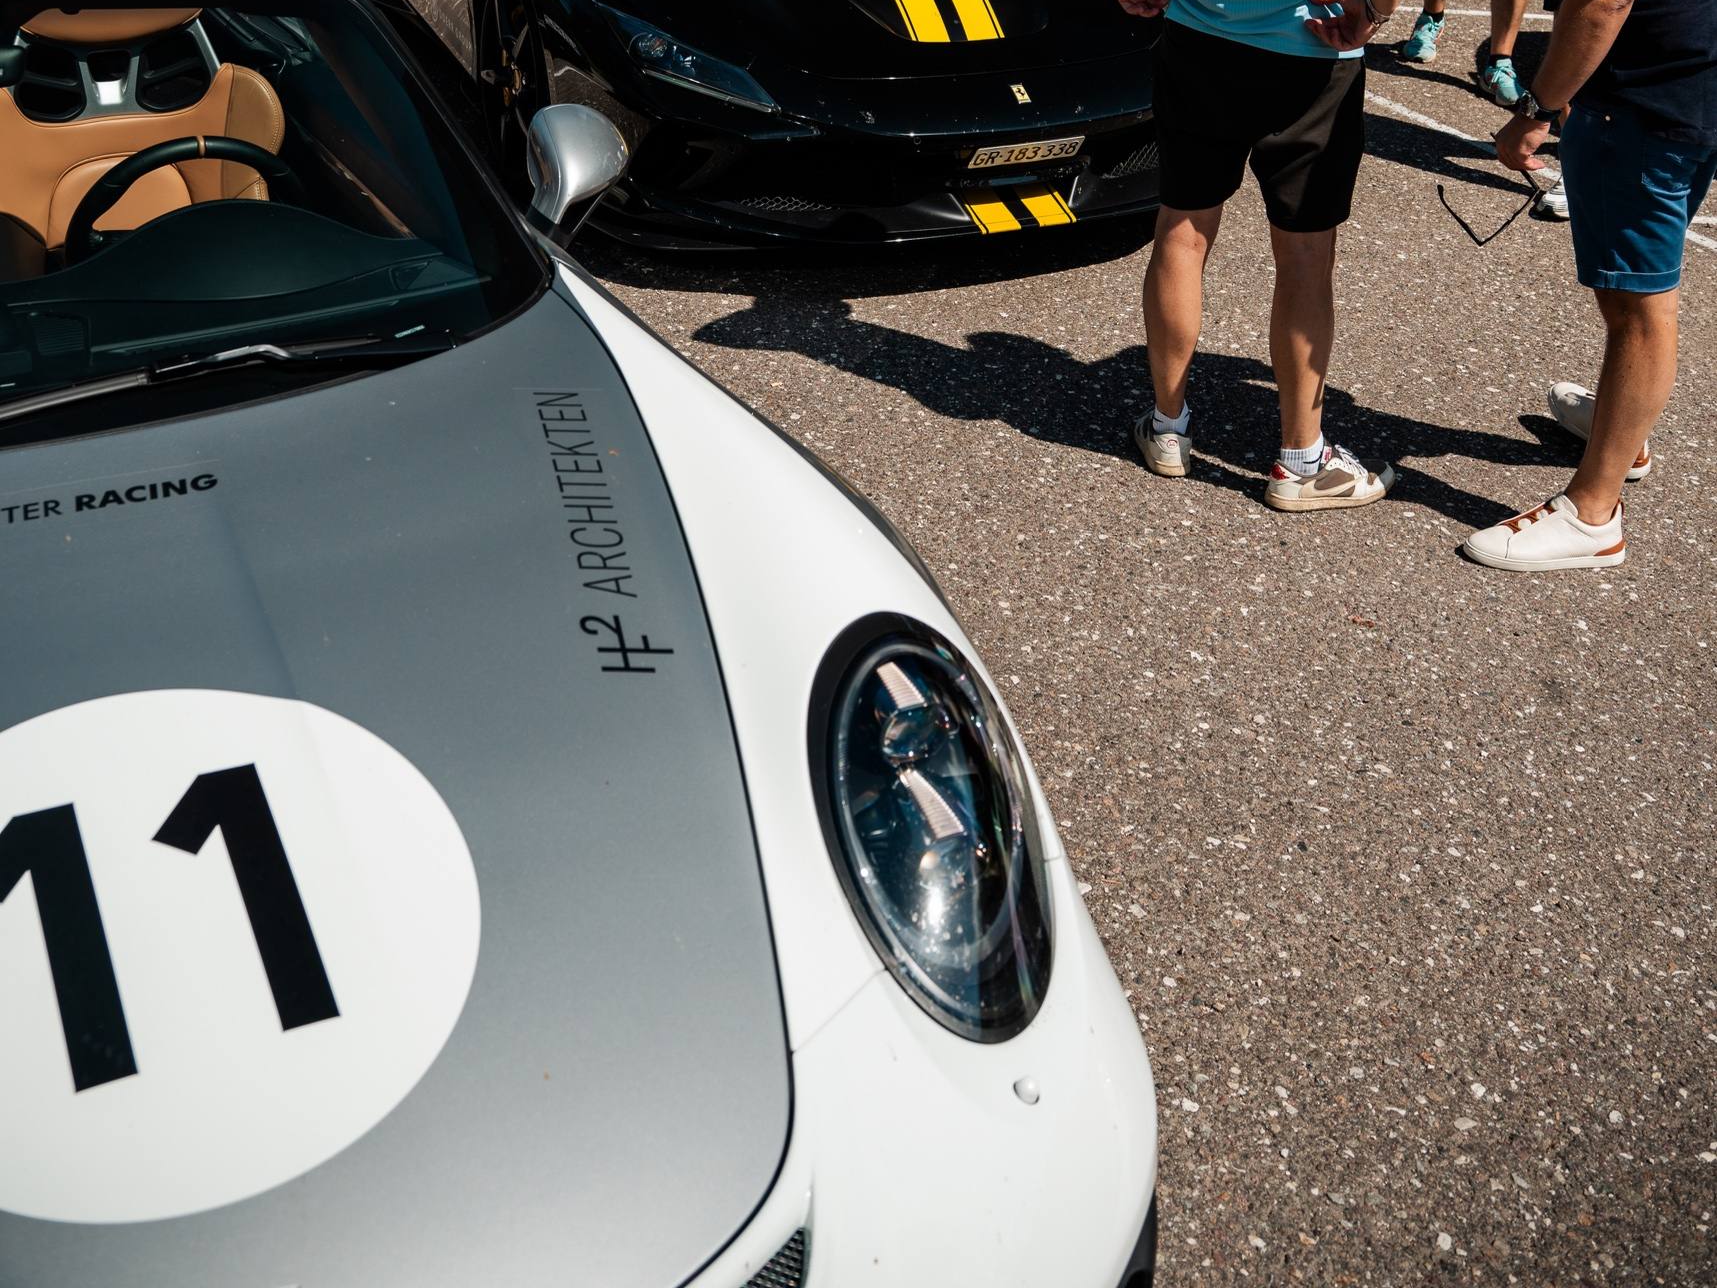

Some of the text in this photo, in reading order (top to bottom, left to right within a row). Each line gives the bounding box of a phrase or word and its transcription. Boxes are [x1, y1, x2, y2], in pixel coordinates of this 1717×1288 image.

[75, 473, 218, 512] RACING
[533, 391, 638, 598] ARCHITEKTEN
[0, 762, 341, 1093] 11
